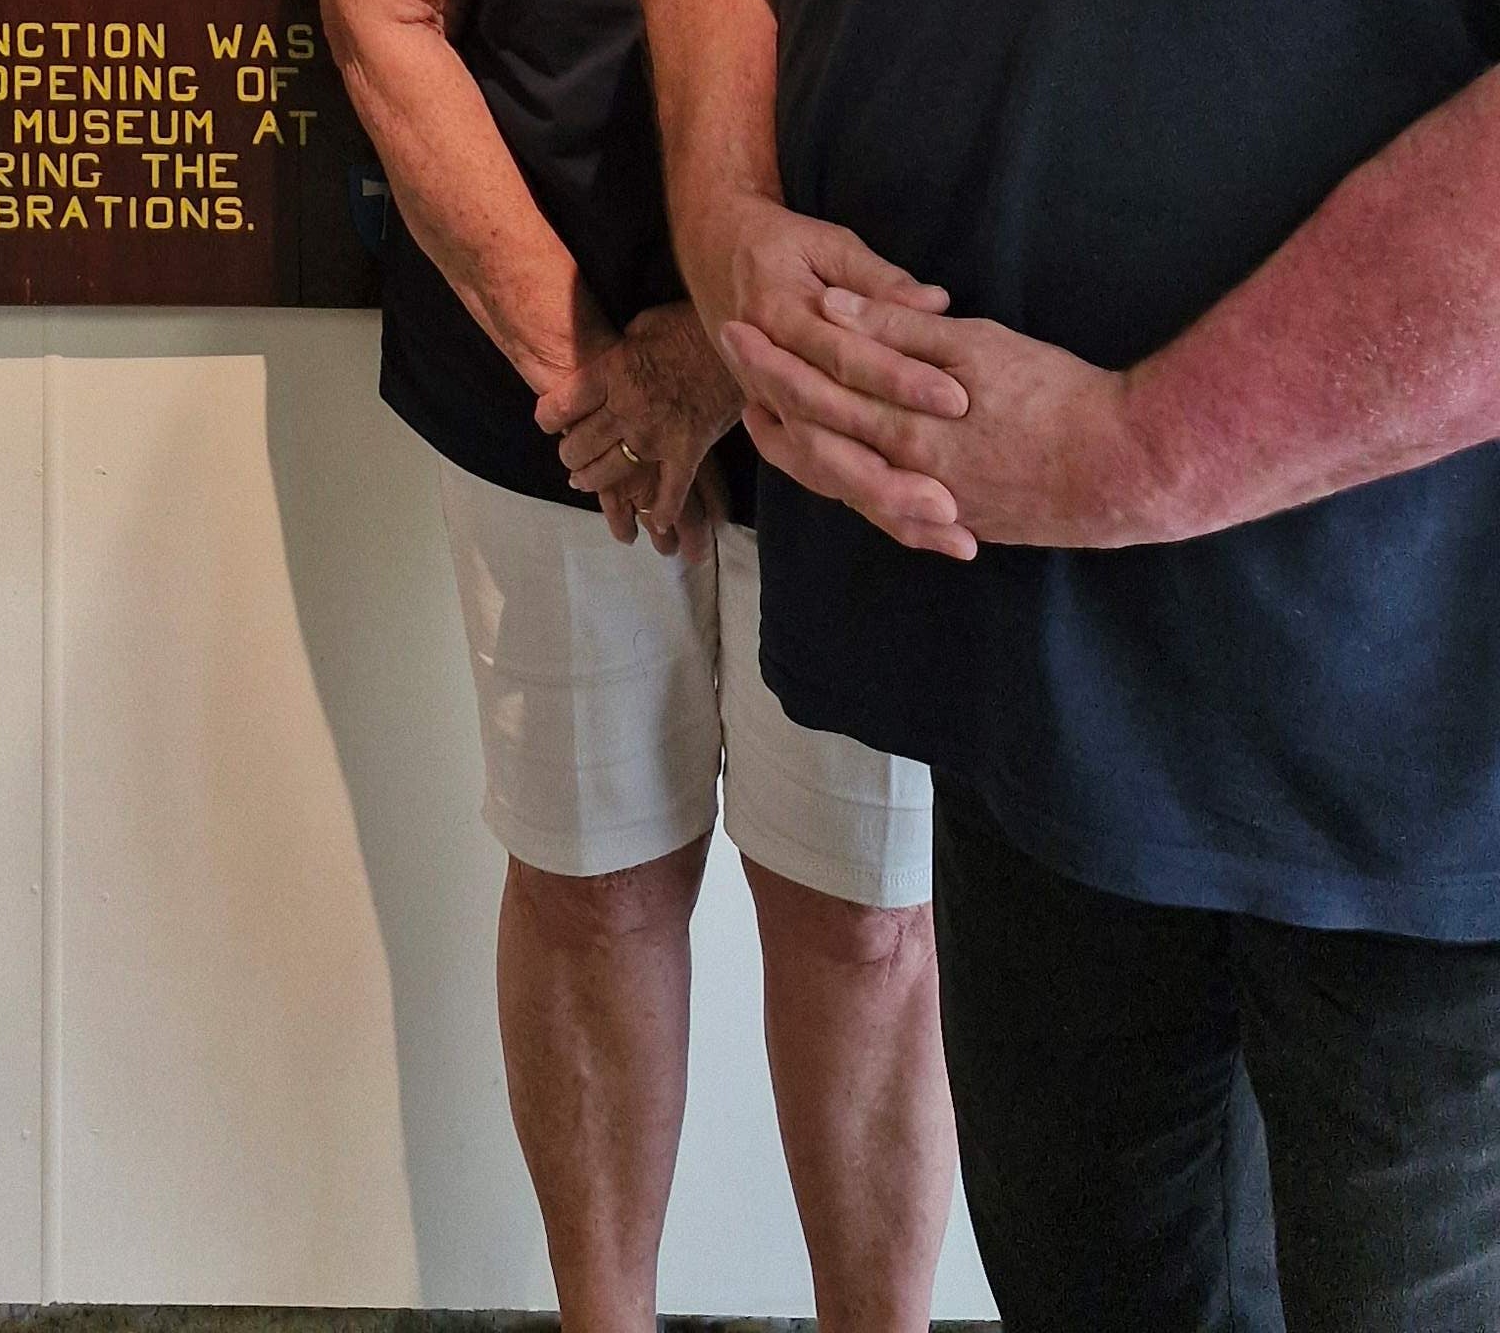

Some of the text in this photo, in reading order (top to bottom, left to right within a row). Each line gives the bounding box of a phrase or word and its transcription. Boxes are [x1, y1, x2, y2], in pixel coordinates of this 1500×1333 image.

[208, 22, 315, 59] WAS
[236, 64, 299, 102] OF
[13, 108, 214, 146] MUSEUM
[252, 108, 318, 146] AT
[142, 151, 238, 189] THE
